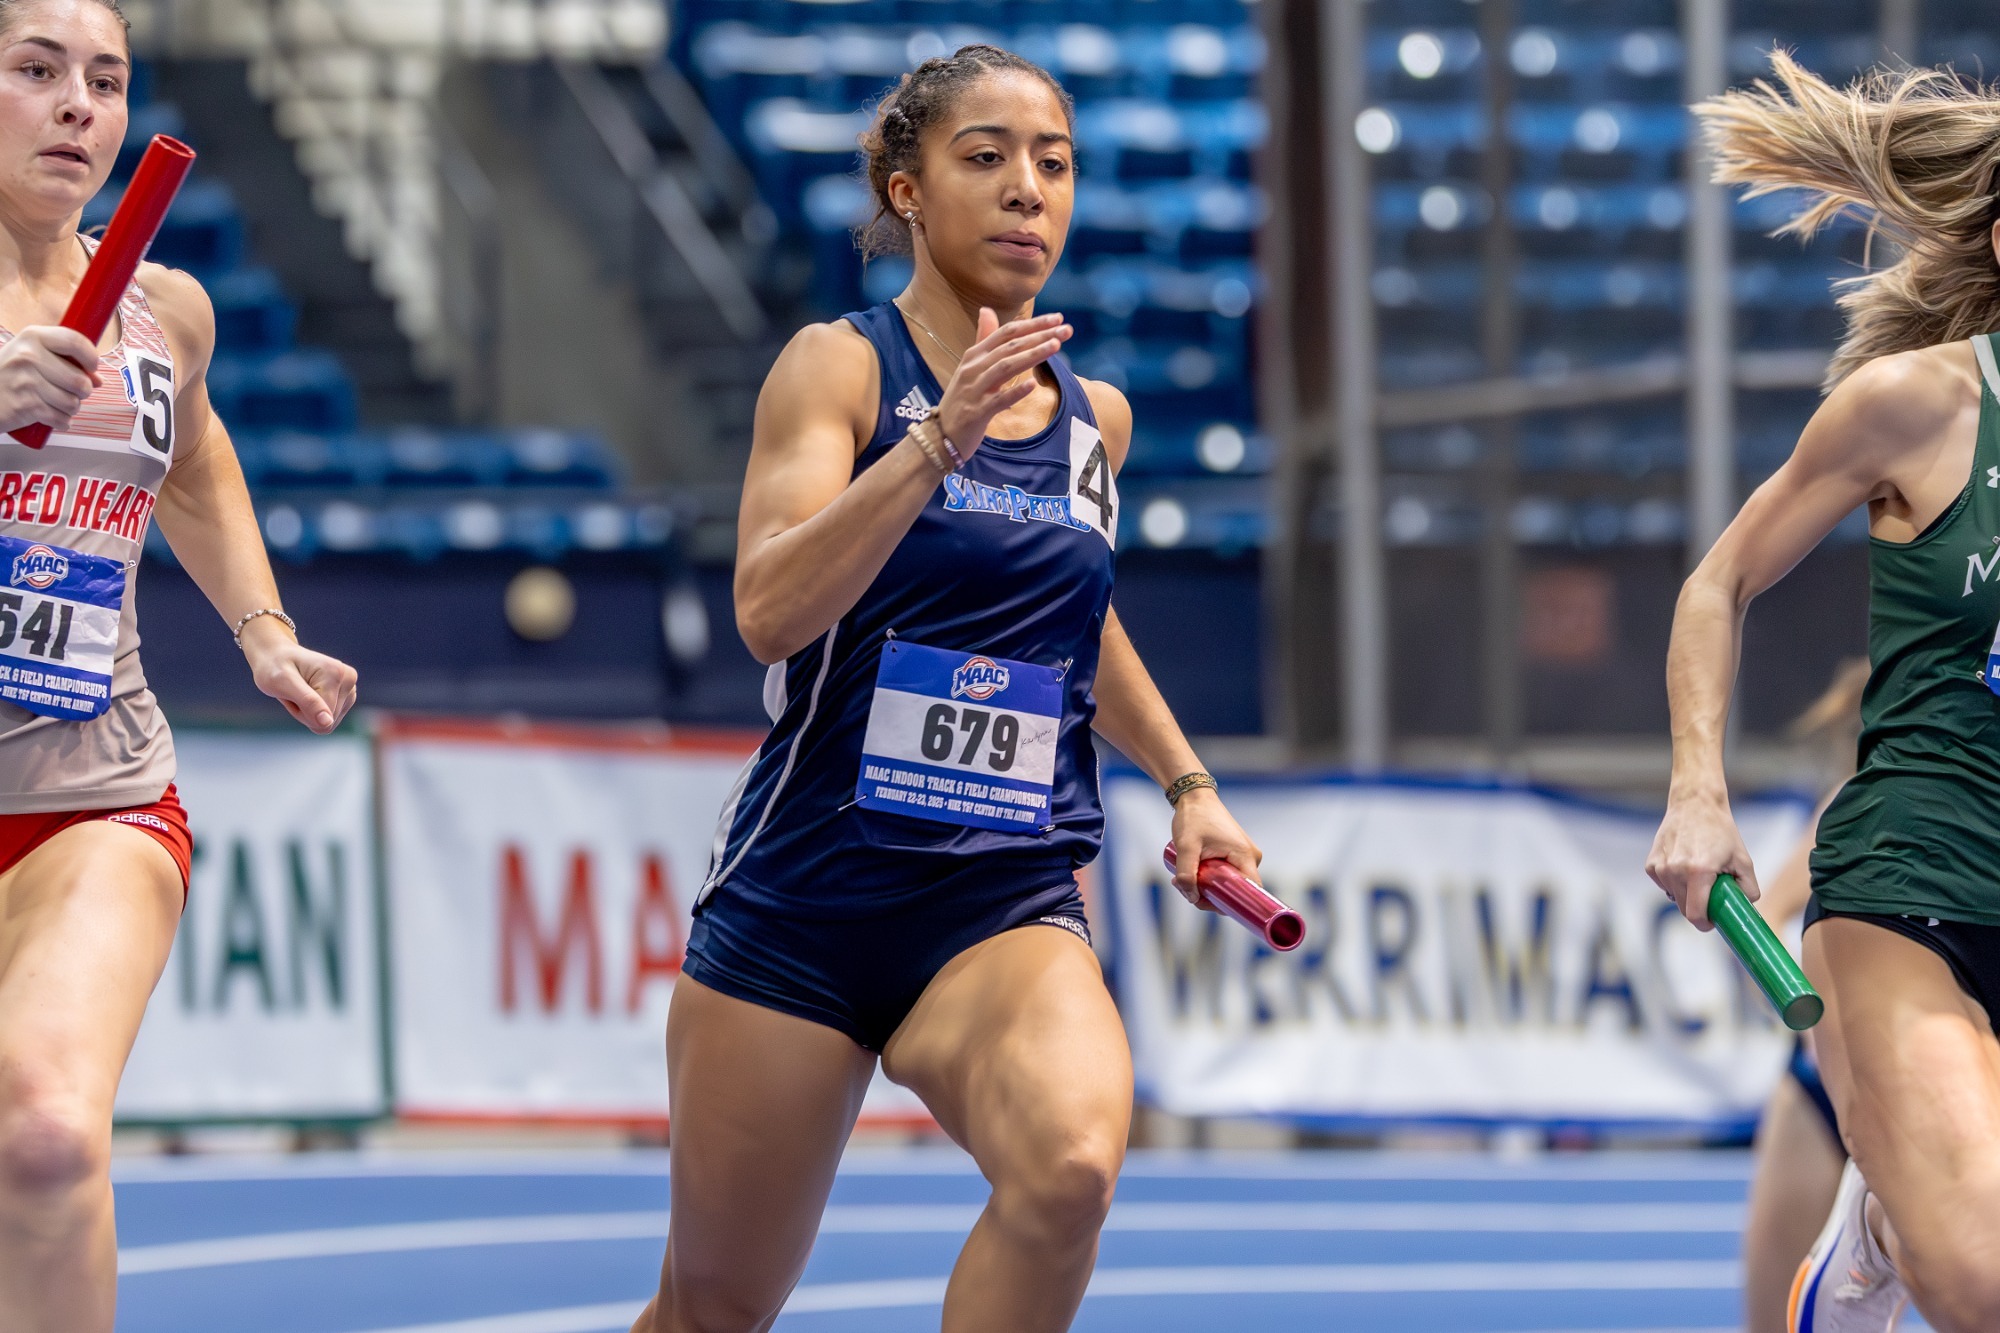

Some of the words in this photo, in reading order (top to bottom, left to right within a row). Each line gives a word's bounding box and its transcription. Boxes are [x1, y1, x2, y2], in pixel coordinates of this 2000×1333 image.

[137, 355, 171, 454] 5
[895, 405, 931, 422] adid
[1077, 439, 1113, 534] 4
[11, 553, 68, 585] MAAC
[20, 669, 44, 687] FIELD
[44, 674, 108, 699] CHAMPIONSHIPS
[952, 666, 1009, 695] MAAC
[29, 690, 52, 706] CENTER
[60, 696, 72, 709] THE
[921, 703, 1019, 772] 679
[864, 764, 891, 782] MAAC
[890, 769, 926, 789] INDOOR
[926, 775, 957, 794] TRACK
[963, 782, 989, 799] FIELD
[989, 786, 1048, 809] CHAMPIONSHIPS
[874, 786, 908, 802] FEBRUARY
[927, 795, 944, 809] 2025
[973, 802, 996, 817] CENTER
[107, 812, 169, 832] adidas
